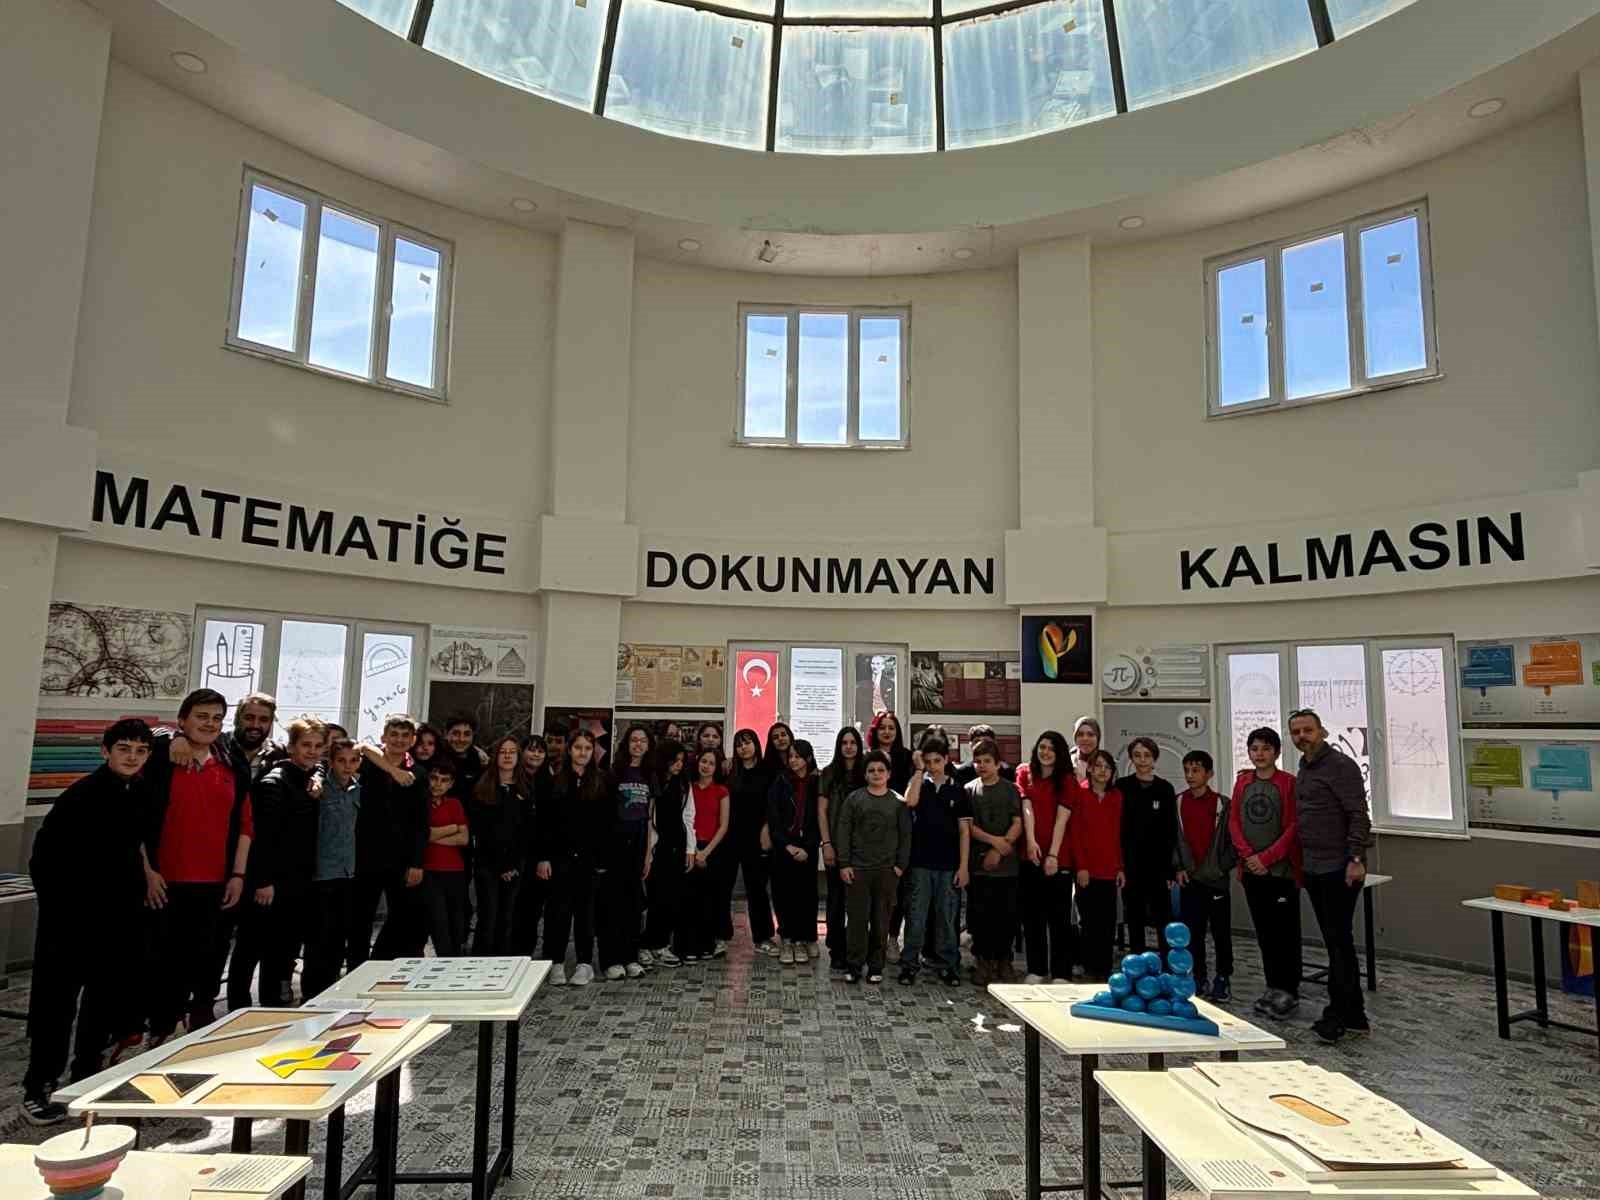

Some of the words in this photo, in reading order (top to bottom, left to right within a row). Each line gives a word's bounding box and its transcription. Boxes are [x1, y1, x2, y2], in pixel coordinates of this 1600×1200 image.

[92, 470, 507, 575] MATEMATİĞE
[1180, 511, 1525, 591] KALMASIN
[646, 550, 995, 594] DOKUNMAYAN
[1184, 716, 1199, 729] Pi
